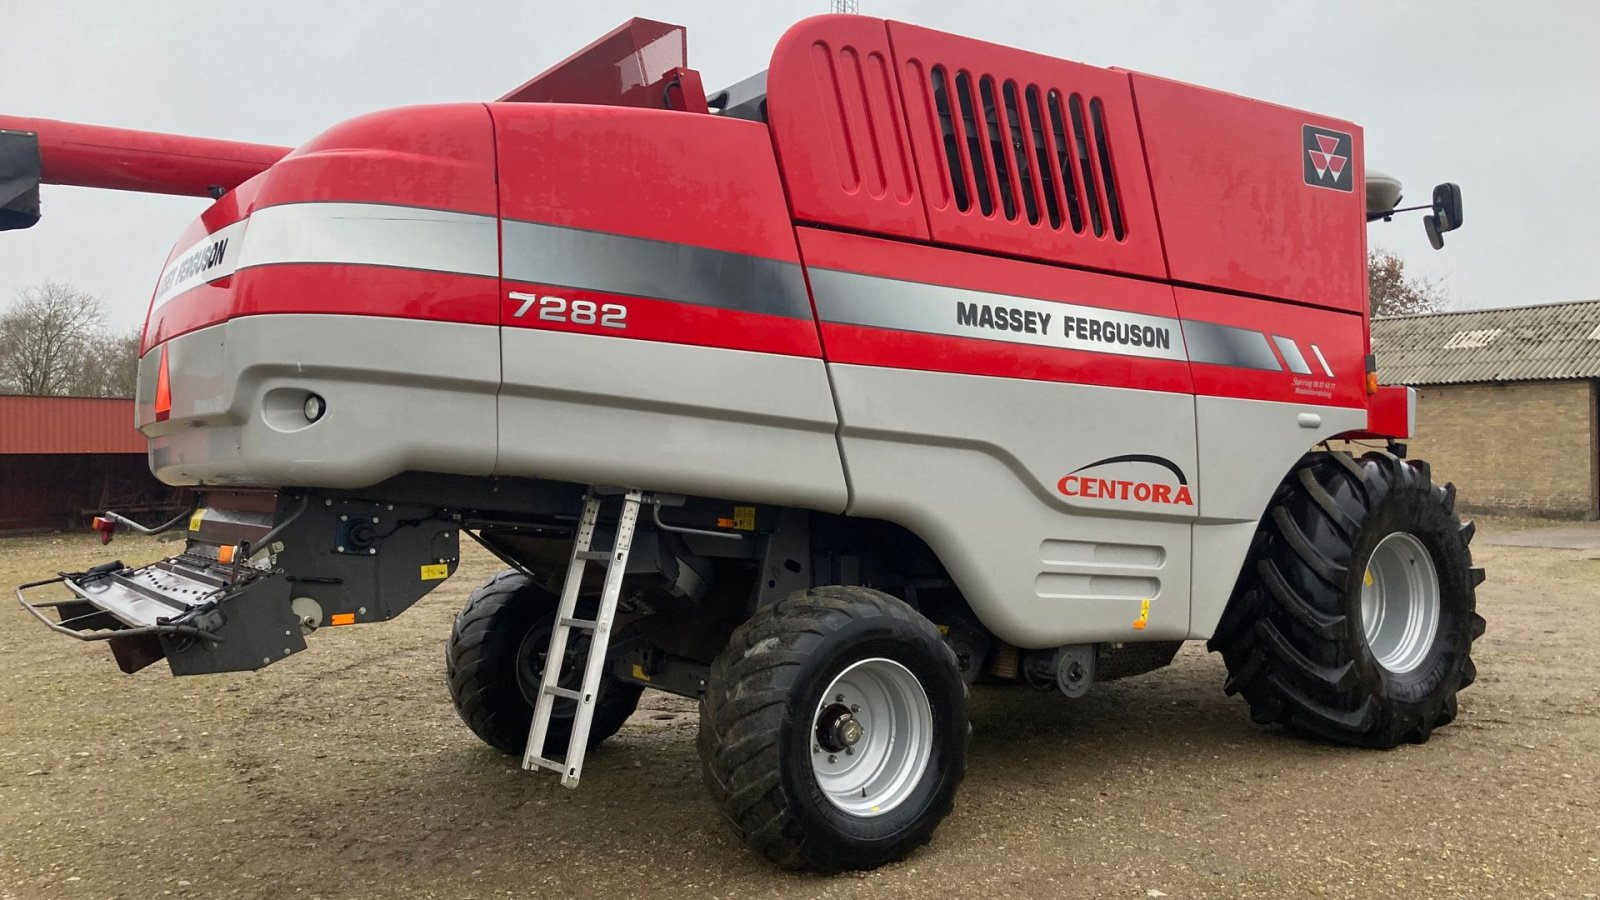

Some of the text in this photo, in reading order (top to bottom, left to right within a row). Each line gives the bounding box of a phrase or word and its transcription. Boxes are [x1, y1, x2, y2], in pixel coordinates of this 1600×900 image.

[175, 237, 229, 285] FERGUSON
[508, 291, 627, 329] 7282
[957, 301, 1170, 349] MASSEY FERGUSON
[1057, 475, 1194, 506] CENTORA
